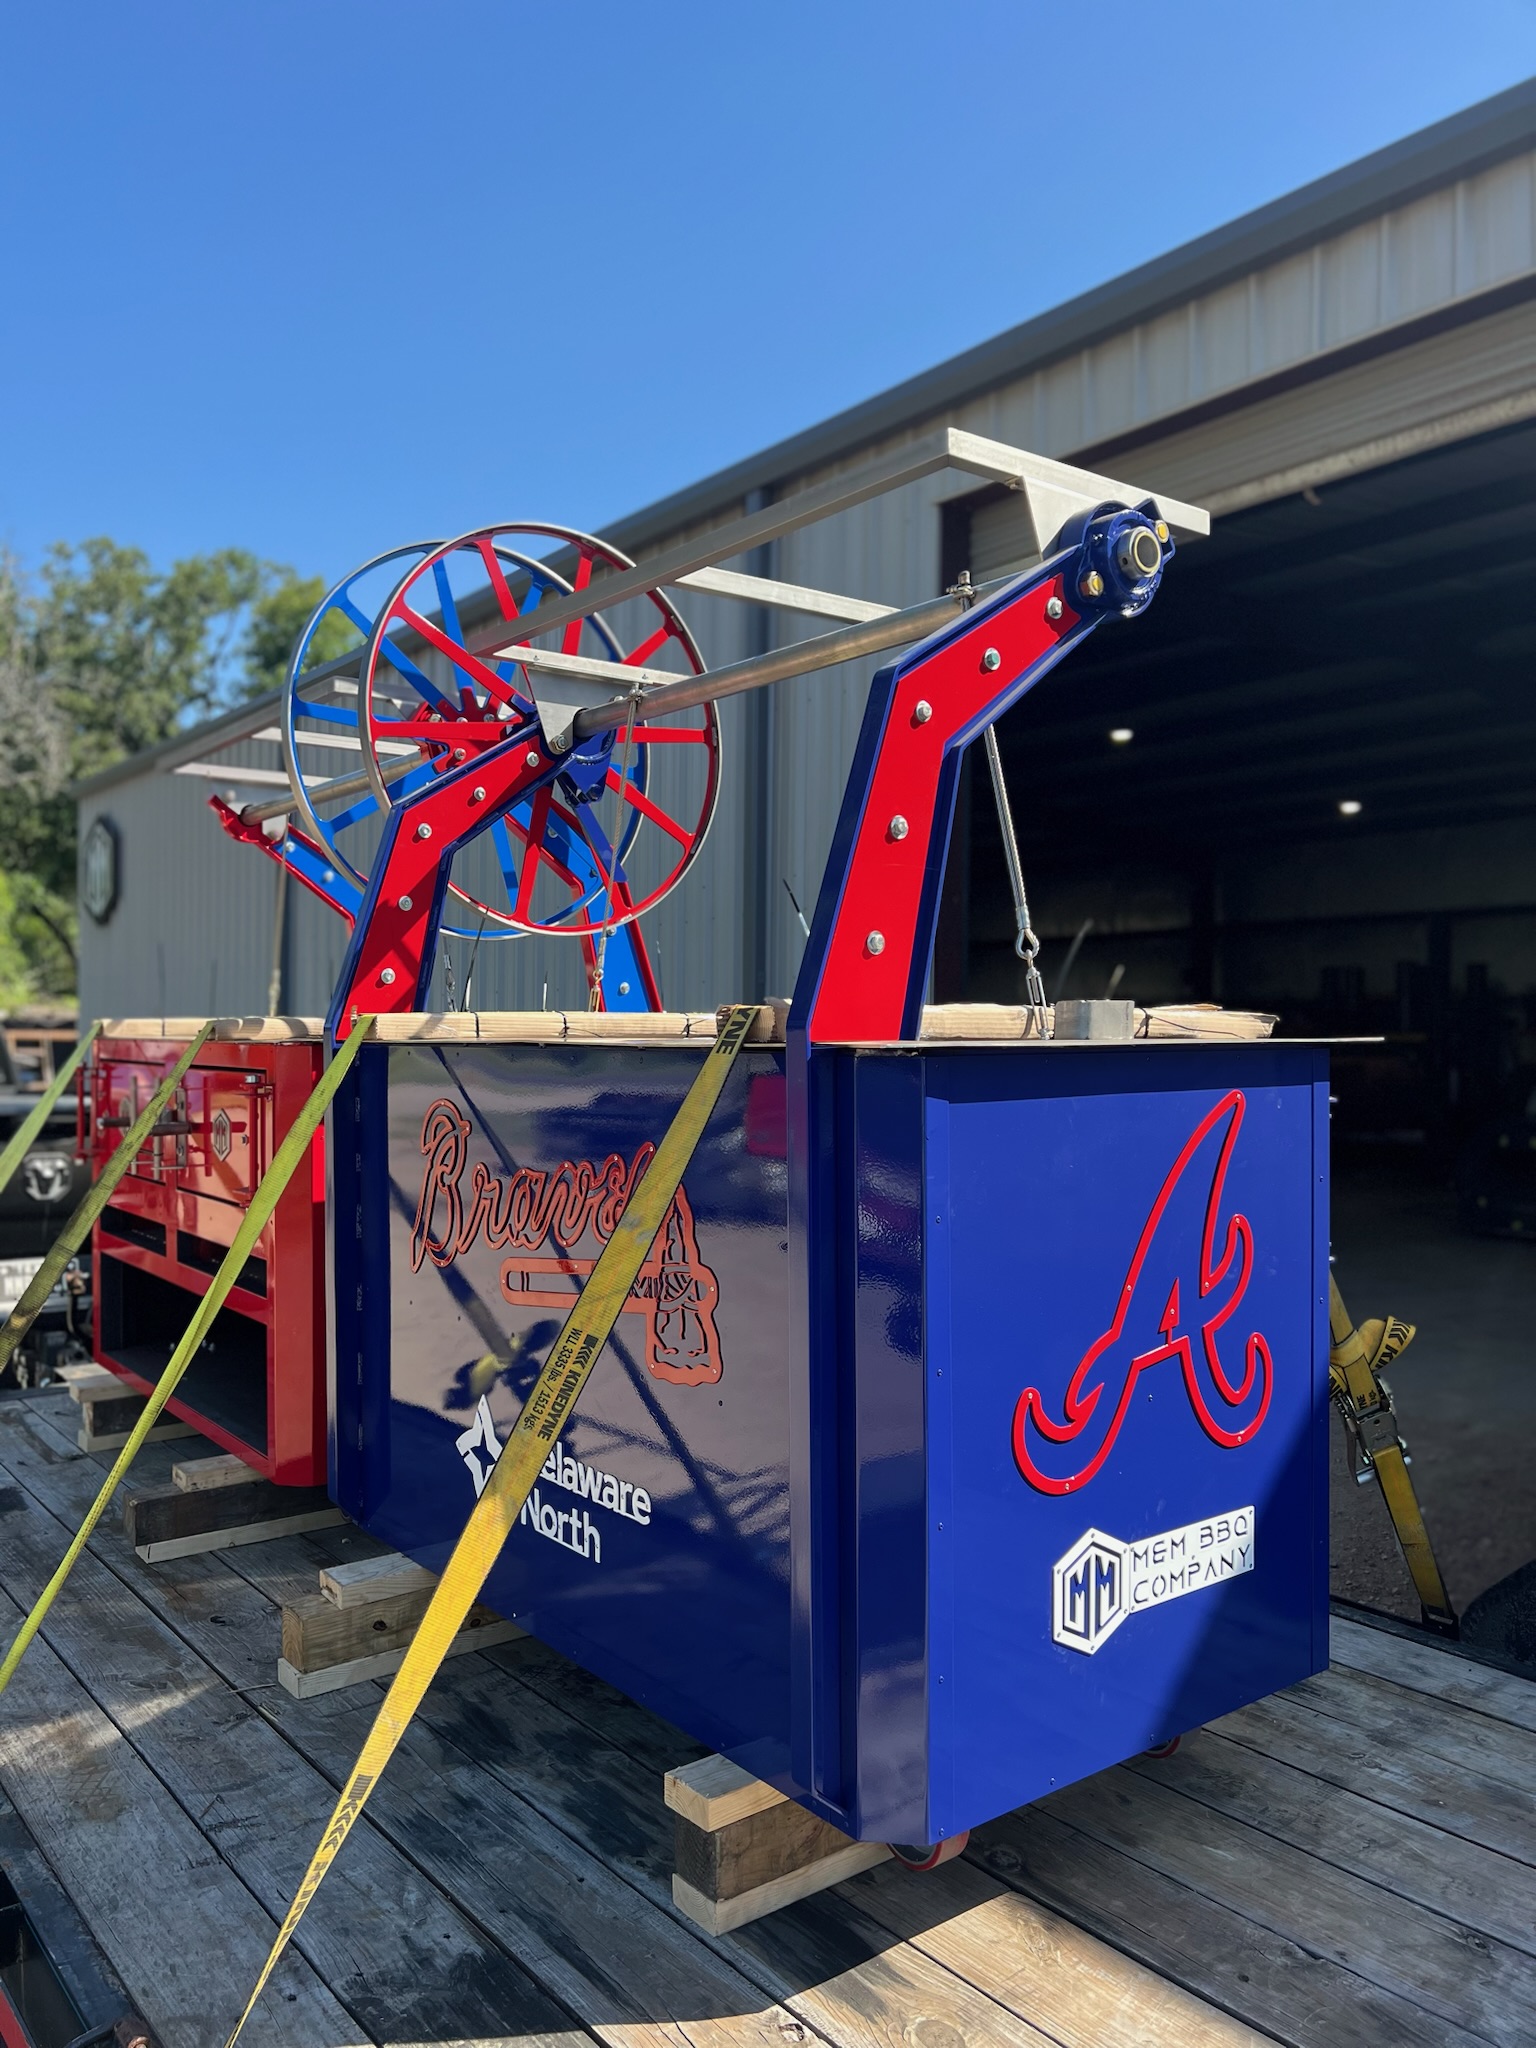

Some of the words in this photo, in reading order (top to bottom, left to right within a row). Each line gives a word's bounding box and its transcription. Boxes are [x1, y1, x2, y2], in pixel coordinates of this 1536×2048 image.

[410, 1097, 657, 1274] Brave
[555, 1345, 574, 1370] 3335
[532, 1389, 551, 1415] 1513
[537, 1369, 582, 1442] KINEDYNE
[539, 1441, 652, 1526] elaware
[520, 1487, 602, 1563] North
[1199, 1514, 1248, 1549] BBQ
[1133, 1543, 1251, 1604] COMPANY
